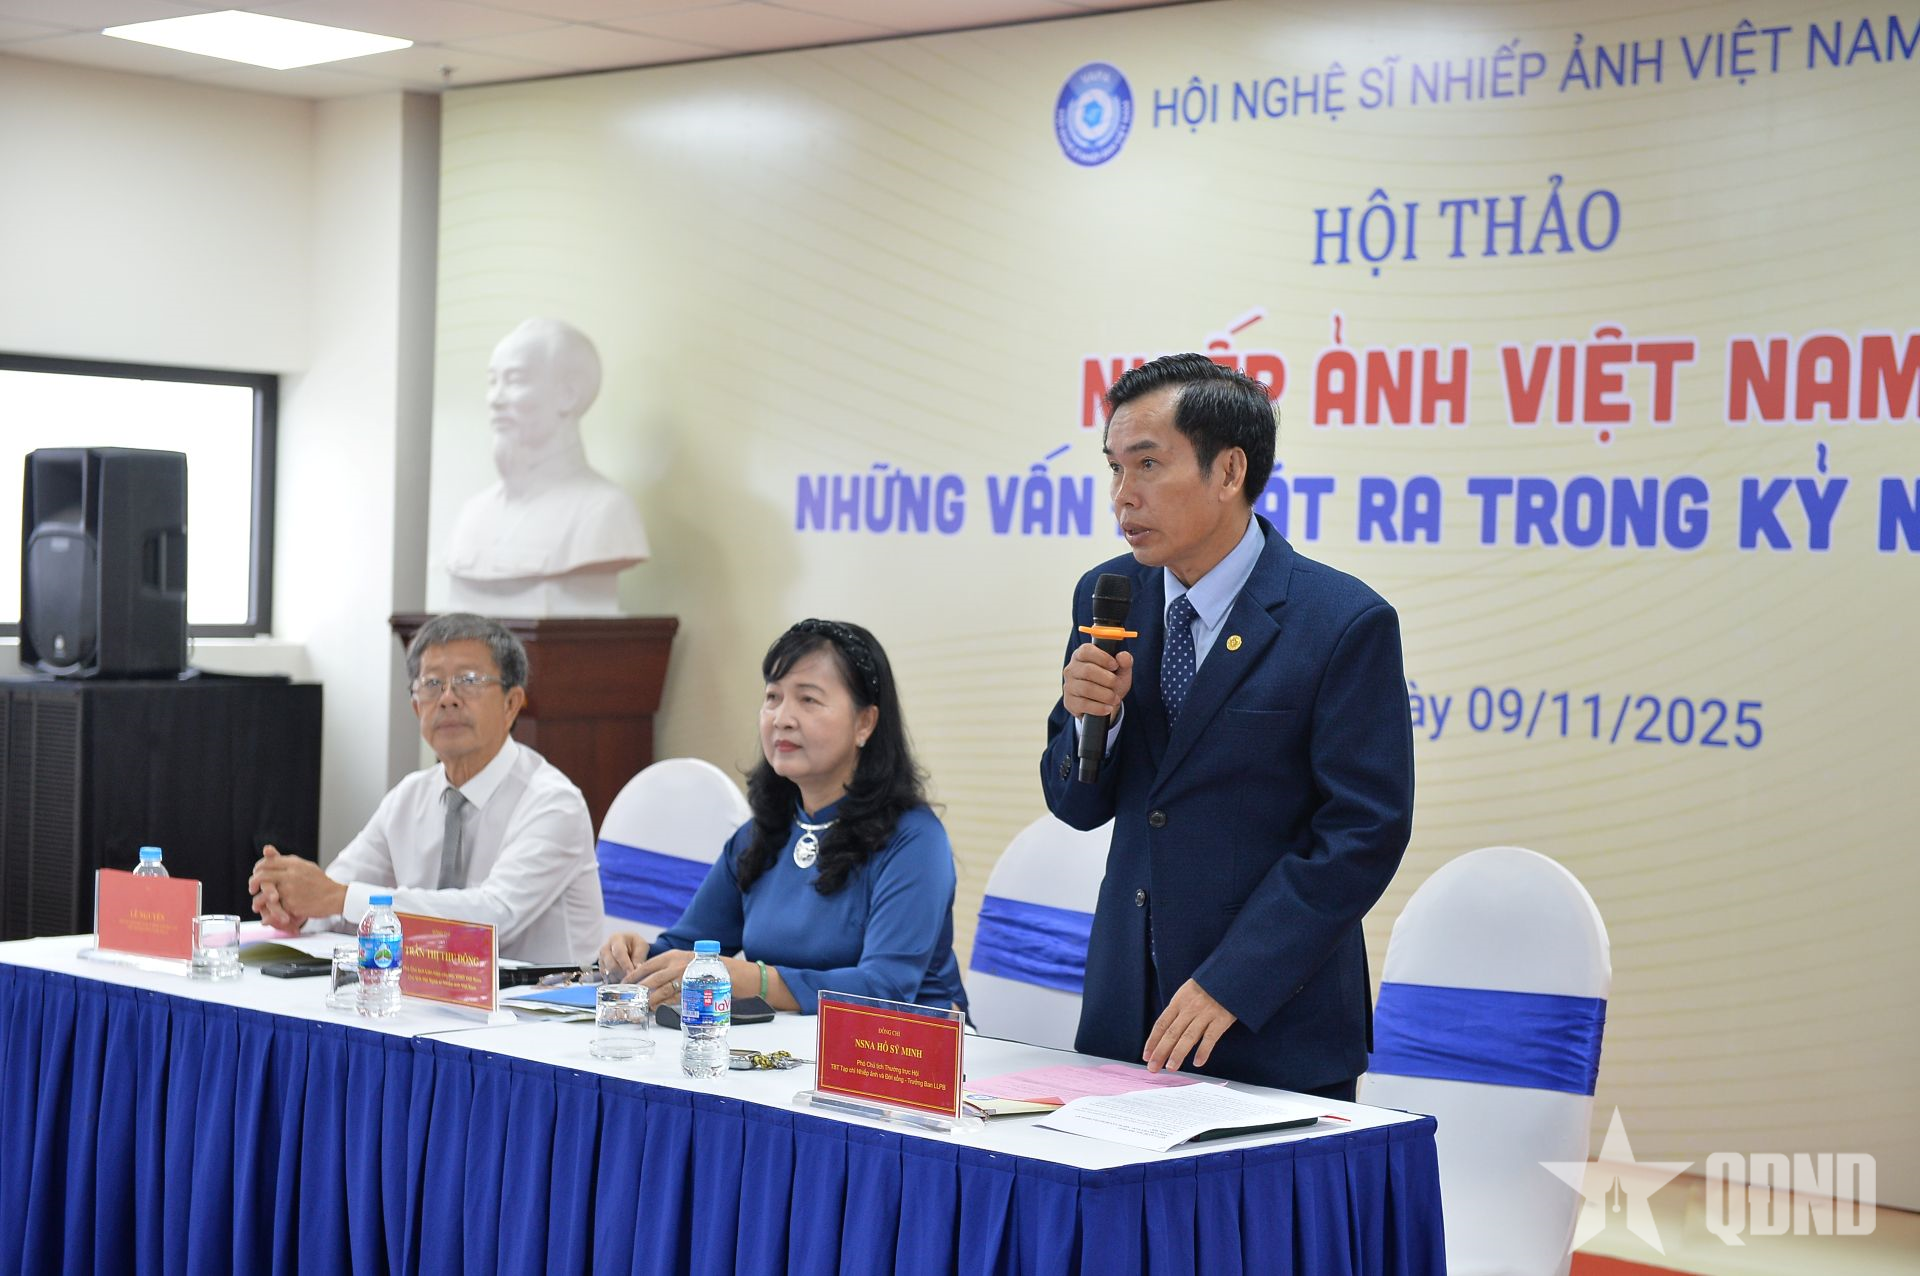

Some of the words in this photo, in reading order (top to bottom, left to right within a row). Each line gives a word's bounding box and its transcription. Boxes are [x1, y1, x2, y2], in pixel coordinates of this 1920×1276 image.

[1153, 76, 1218, 133] HỘI
[1232, 61, 1346, 121] NGHỆ
[1358, 55, 1401, 110] SĨ
[1410, 38, 1547, 105] NHIẾP
[1558, 32, 1663, 92] ẢNH
[1680, 19, 1792, 85] VIỆT
[1807, 15, 1920, 69] NAM
[1312, 188, 1420, 277] HỘI
[1439, 174, 1621, 258] THẢO
[1313, 314, 1469, 426] ẢNH
[1501, 327, 1695, 443] VIỆT
[1728, 335, 1920, 421] NAM
[795, 463, 965, 534] NHỮNG
[987, 444, 1093, 536] VẤN
[1358, 476, 1441, 542] RA
[1468, 475, 1709, 549] TRONG
[1739, 442, 1849, 550] KỶ
[1409, 681, 1452, 740] ày
[1467, 686, 1763, 749] 09/11/2025
[855, 1038, 875, 1050] NSNA
[901, 1046, 922, 1059] MINH
